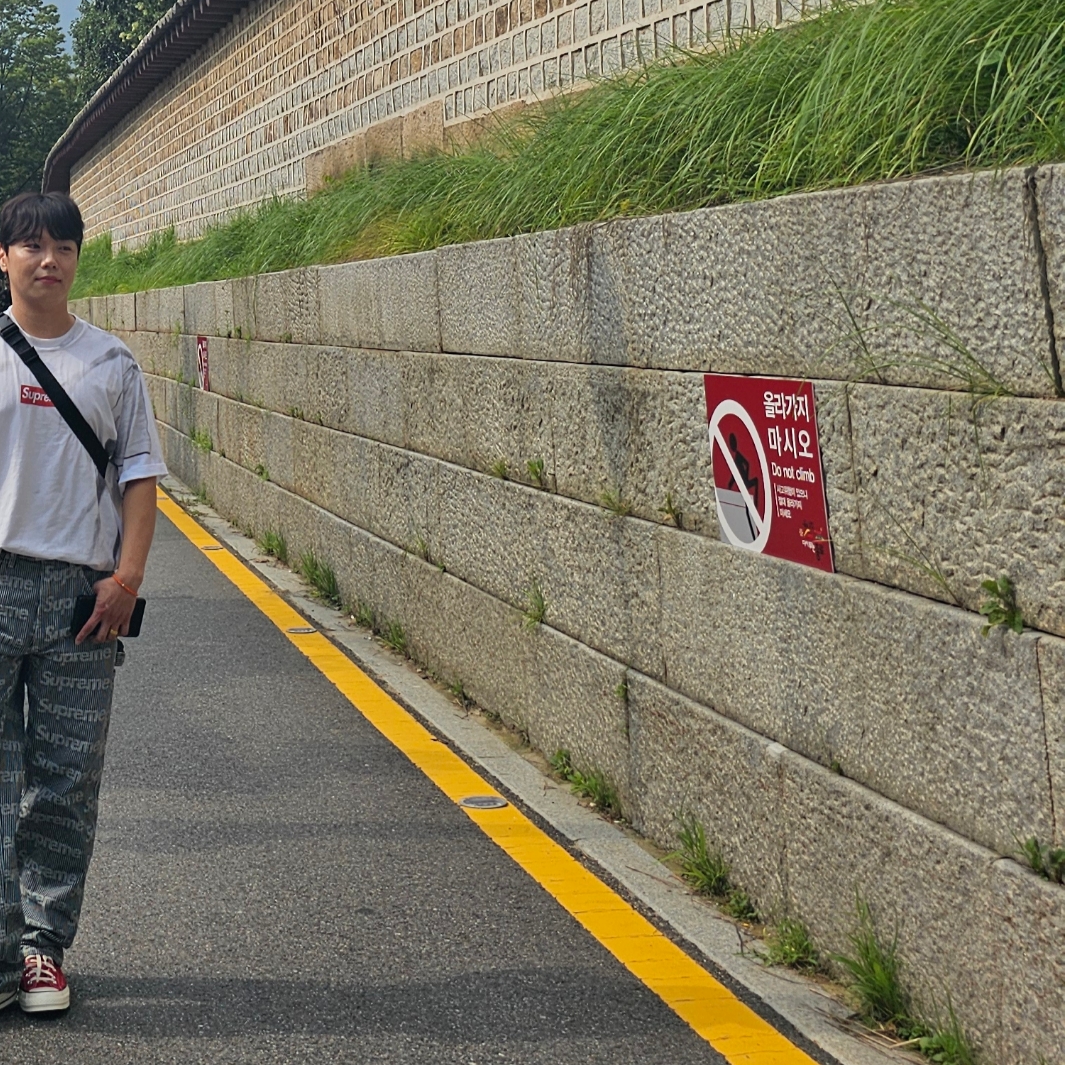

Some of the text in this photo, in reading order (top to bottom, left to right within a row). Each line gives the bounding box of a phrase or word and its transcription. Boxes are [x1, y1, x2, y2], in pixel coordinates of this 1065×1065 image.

[22, 387, 52, 403] Supre
[763, 391, 810, 423] 올라가지
[767, 425, 814, 459] 마시오
[771, 462, 815, 484] Do not climb
